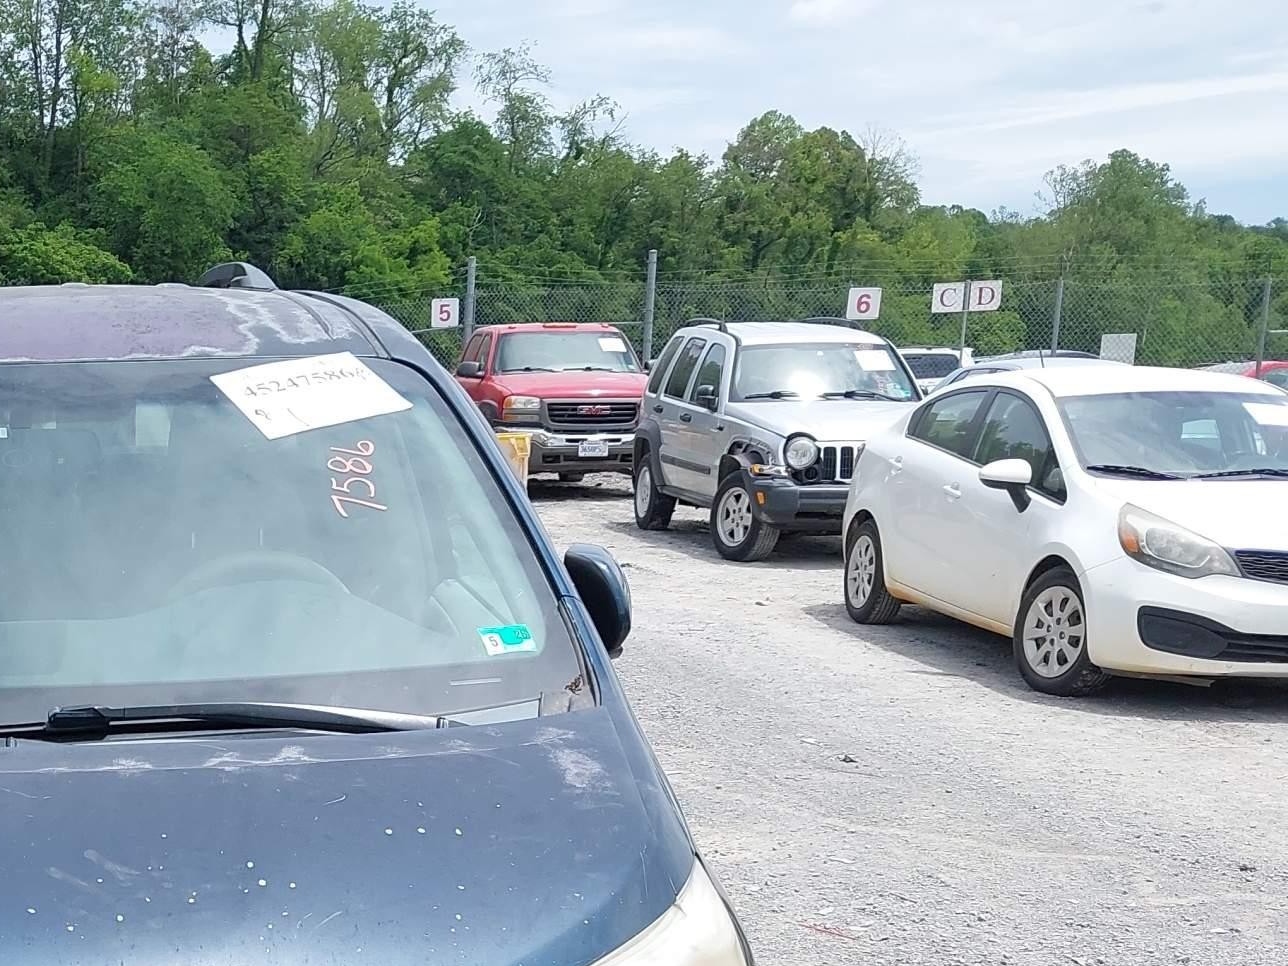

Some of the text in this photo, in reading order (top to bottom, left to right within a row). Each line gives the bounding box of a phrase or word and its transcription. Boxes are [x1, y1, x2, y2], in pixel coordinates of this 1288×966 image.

[856, 293, 871, 313] 6
[940, 286, 958, 308] C
[977, 284, 996, 306] D
[438, 304, 451, 322] 5
[326, 439, 388, 519] 7586
